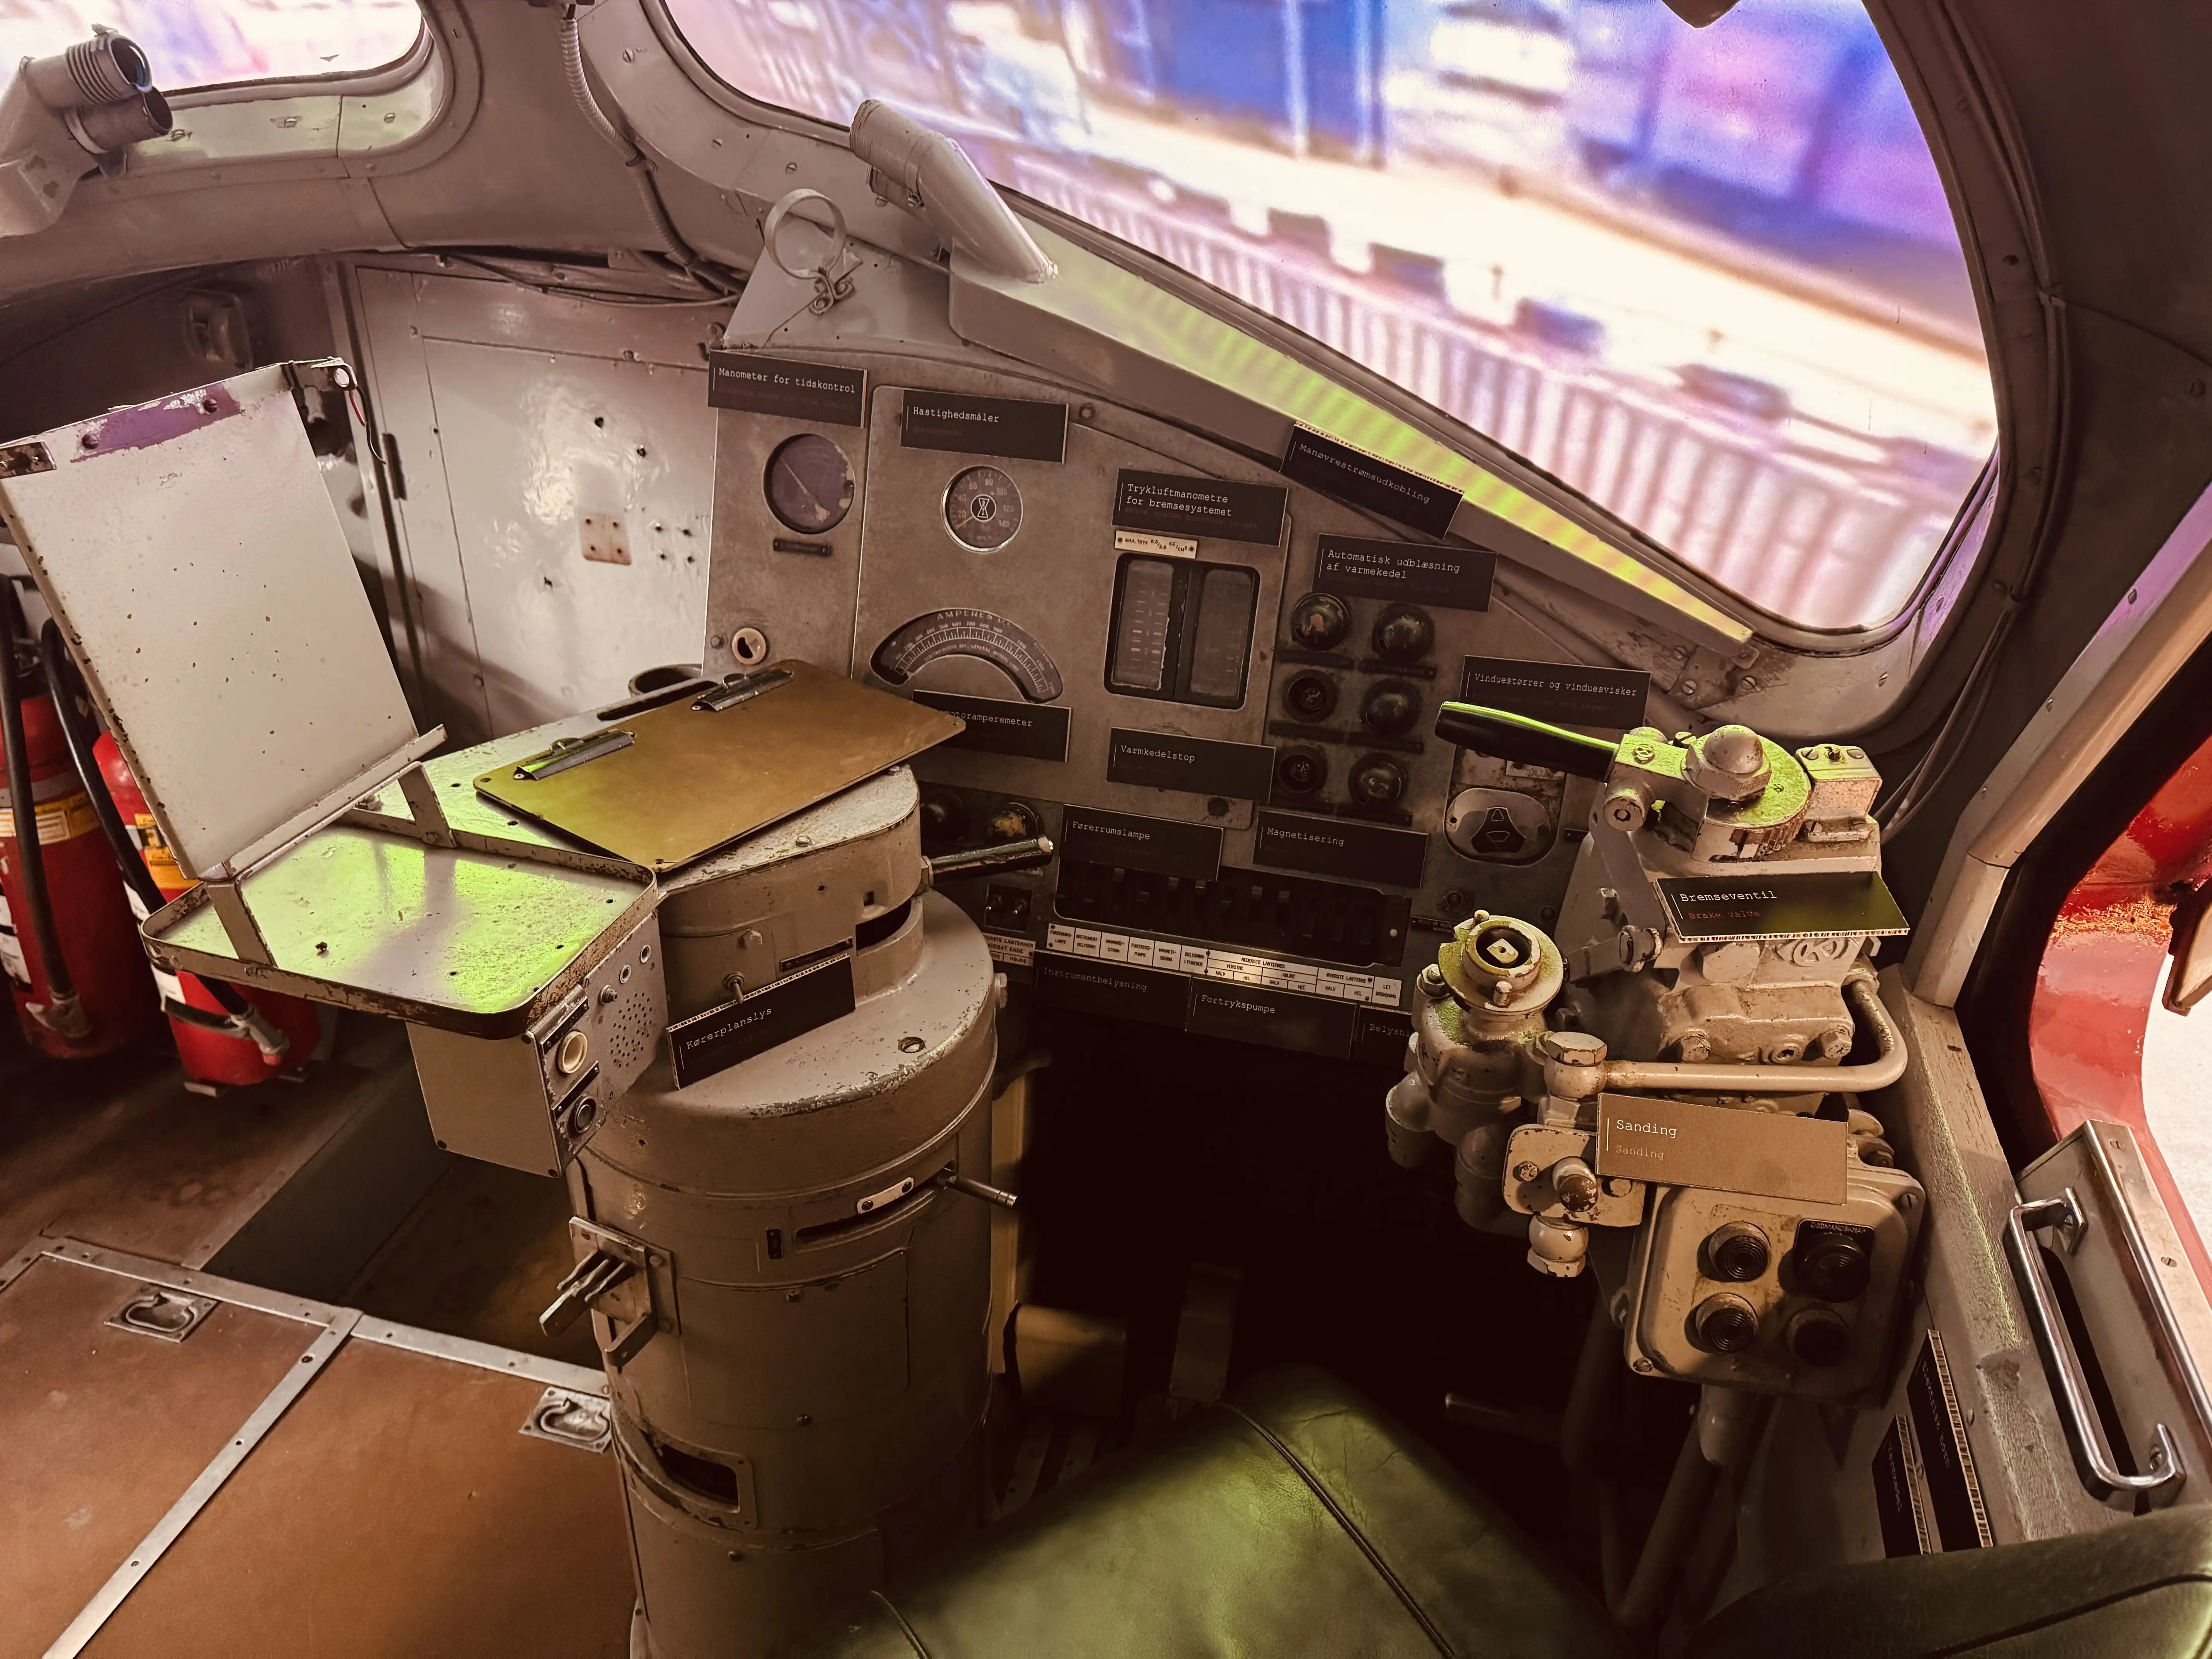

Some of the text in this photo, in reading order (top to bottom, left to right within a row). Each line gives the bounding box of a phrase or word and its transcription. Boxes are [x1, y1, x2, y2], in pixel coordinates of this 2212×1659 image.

[719, 368, 855, 393] Manometer for tidskontrol
[913, 406, 1000, 423] Hastighedsmåler
[1300, 443, 1430, 504] Manøvrestrømsudkobling
[1128, 483, 1229, 503] Trykluftmanometre
[1126, 496, 1232, 517] for bremsesystemet
[1327, 550, 1461, 574] Automatisk udblæsning
[1345, 565, 1407, 579] varmekedel
[937, 610, 993, 620] AMPERES
[1474, 673, 1637, 696] Vinduestørrer og vinduesvisker
[1121, 745, 1195, 763] Varmkedelstop
[1072, 821, 1151, 840] Førerrumslampe
[1267, 826, 1345, 847] Magnetisering
[1679, 890, 1778, 902] Bremseventil
[1043, 967, 1147, 992] Instrumentbelysning
[1201, 994, 1276, 1014] Fortrykspumpe
[686, 1008, 772, 1049] Kørerplanslys
[1369, 1024, 1410, 1037] Belysni
[1616, 1120, 1678, 1139] Sanding
[1616, 1145, 1664, 1161] Sanding
